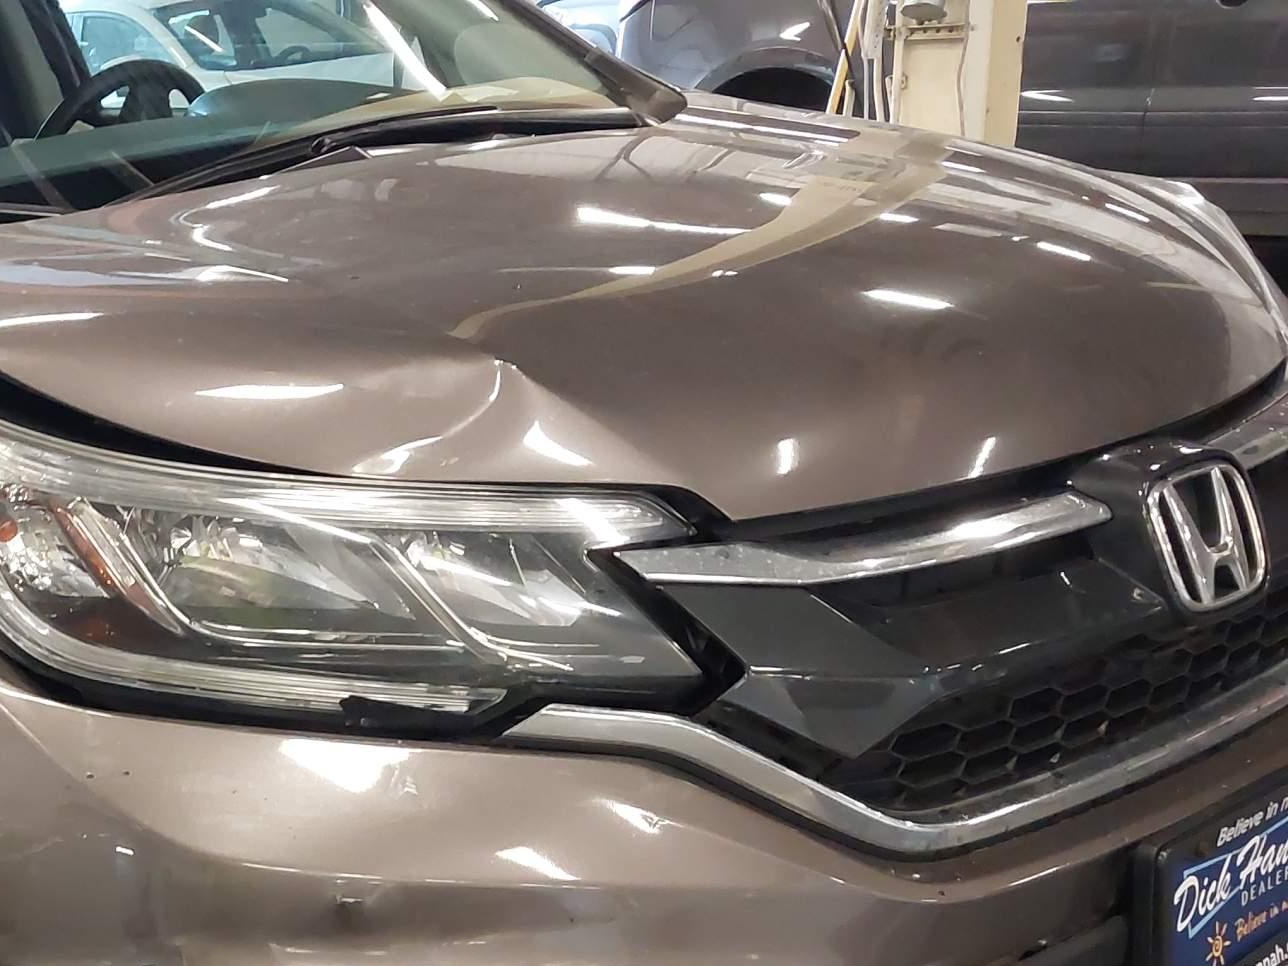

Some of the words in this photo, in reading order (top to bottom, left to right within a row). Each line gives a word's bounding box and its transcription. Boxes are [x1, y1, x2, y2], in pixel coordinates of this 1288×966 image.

[1216, 811, 1264, 847] Believe
[1265, 801, 1279, 820] in
[1173, 853, 1231, 932] Dick
